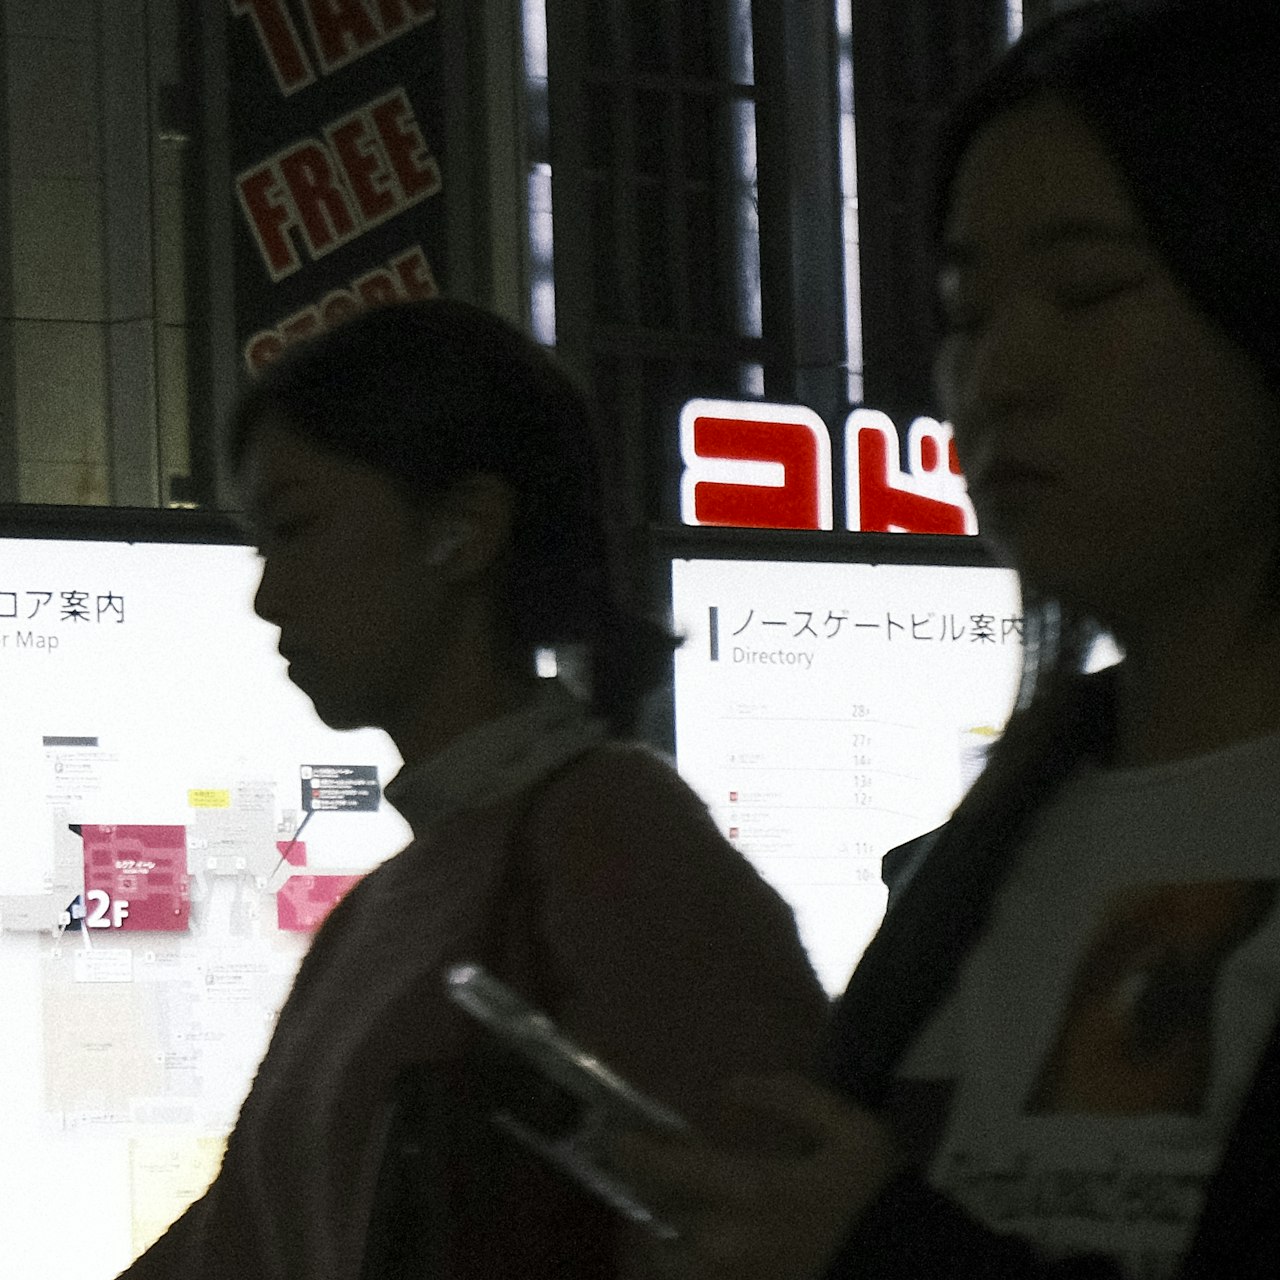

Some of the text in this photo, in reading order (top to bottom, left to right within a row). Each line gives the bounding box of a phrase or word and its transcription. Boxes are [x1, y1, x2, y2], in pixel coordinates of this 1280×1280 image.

[230, 0, 437, 97] TA
[236, 87, 442, 283] FREE
[16, 630, 60, 653] Map
[732, 646, 815, 670] Directory
[86, 889, 129, 928] 2F
